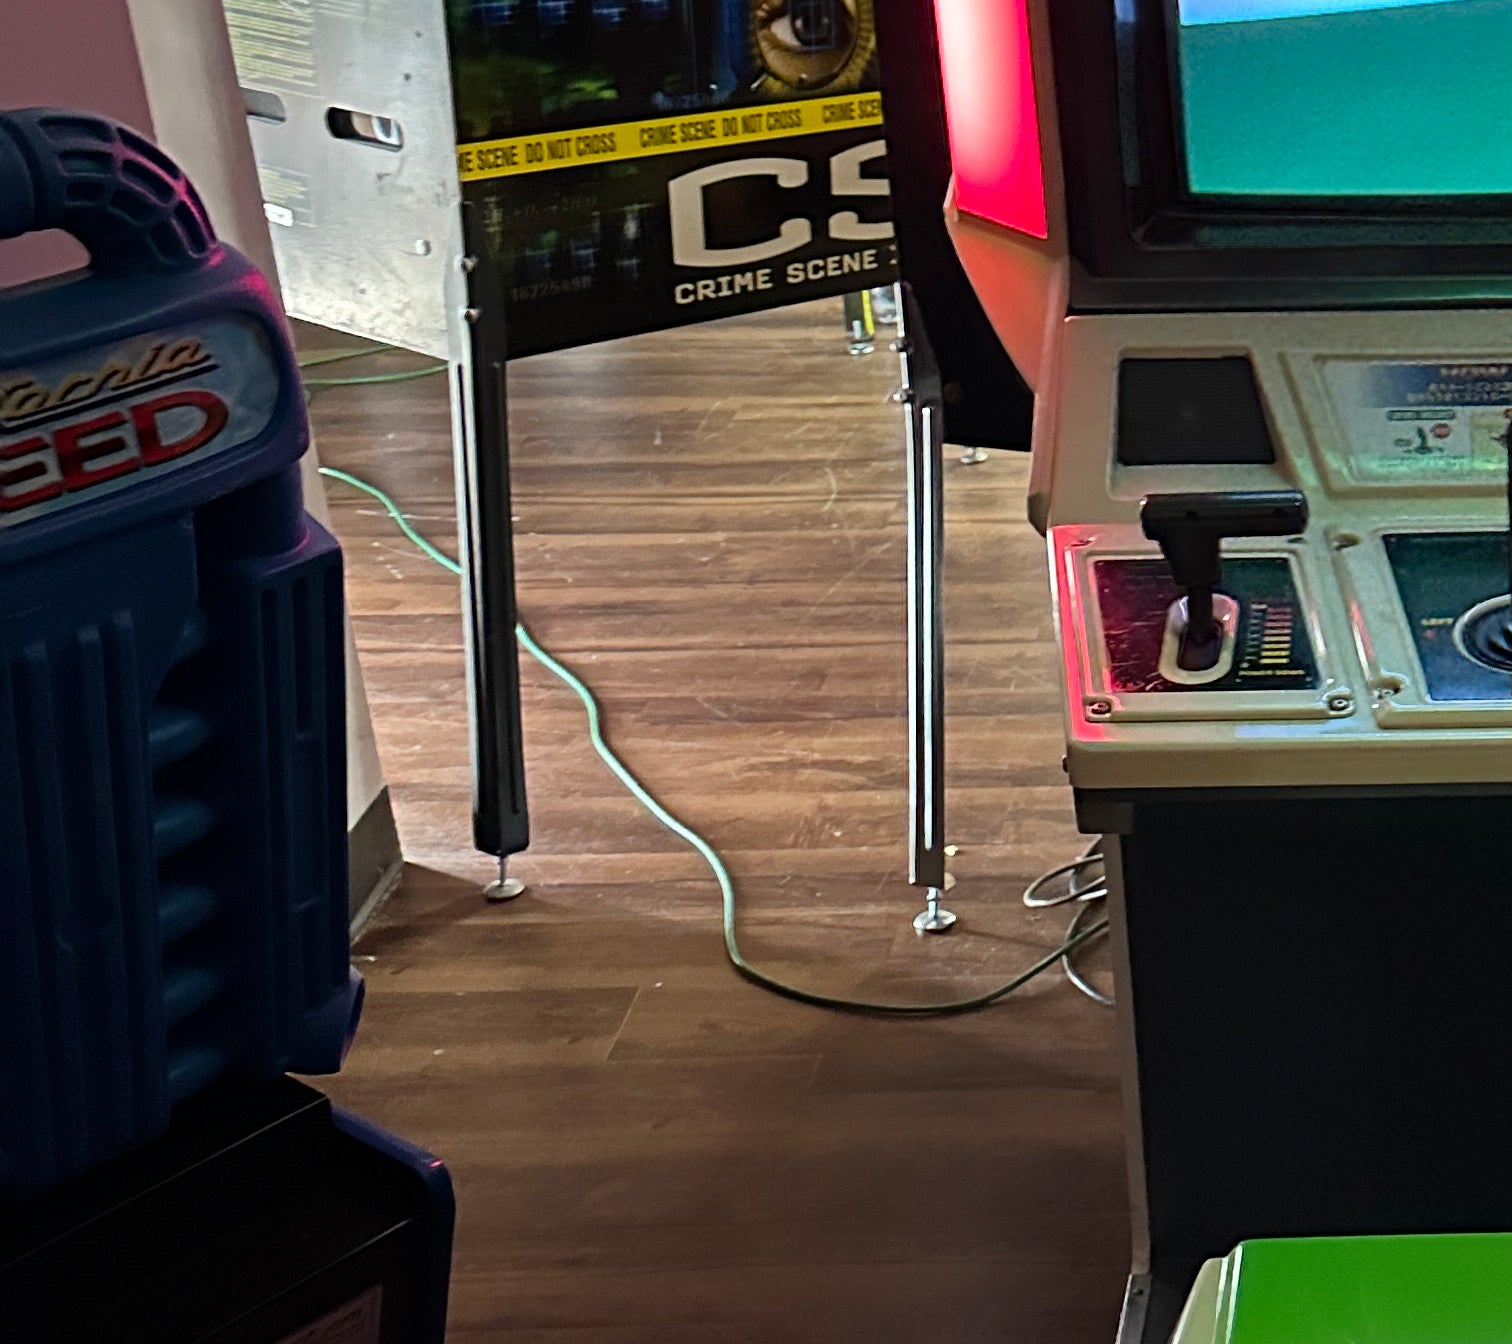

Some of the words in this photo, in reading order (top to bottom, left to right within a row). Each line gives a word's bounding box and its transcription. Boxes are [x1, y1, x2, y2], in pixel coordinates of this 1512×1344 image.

[476, 145, 519, 171] SCENE
[525, 142, 544, 164] DO
[547, 138, 571, 160] NOT
[575, 132, 617, 157] CROSS
[639, 124, 677, 148] CRIME
[680, 119, 717, 143] SCENE
[722, 116, 738, 137] DO
[741, 112, 763, 134] NOT
[766, 108, 803, 132] CROSS
[822, 101, 855, 124] CRIME
[674, 268, 773, 304] CRIME
[786, 249, 879, 284] SCENE
